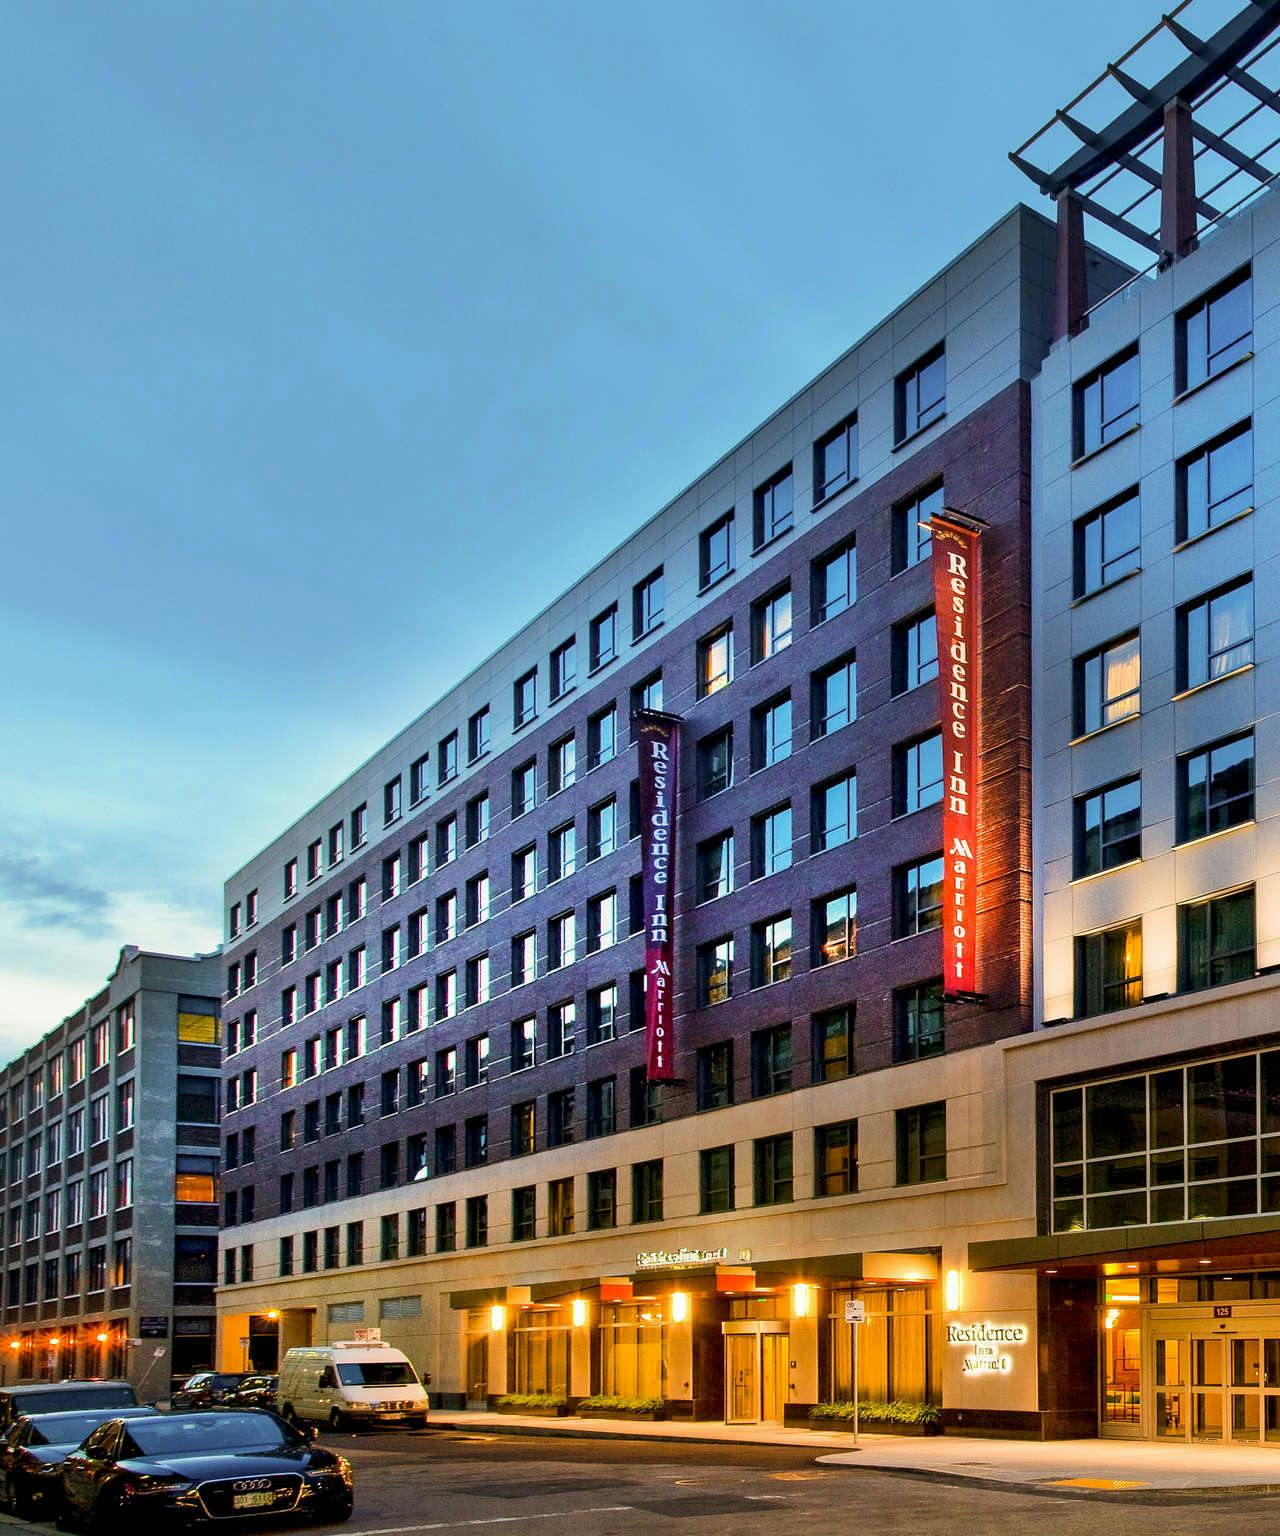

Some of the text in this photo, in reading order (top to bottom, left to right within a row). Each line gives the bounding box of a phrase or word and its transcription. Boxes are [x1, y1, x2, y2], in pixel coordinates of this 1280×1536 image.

[947, 552, 973, 979] Residence Inn Marriott
[650, 741, 671, 1068] Residence Inn Marriott
[1217, 1307, 1229, 1316] 125
[946, 1324, 1024, 1342] Residence
[975, 1344, 993, 1356] Inn
